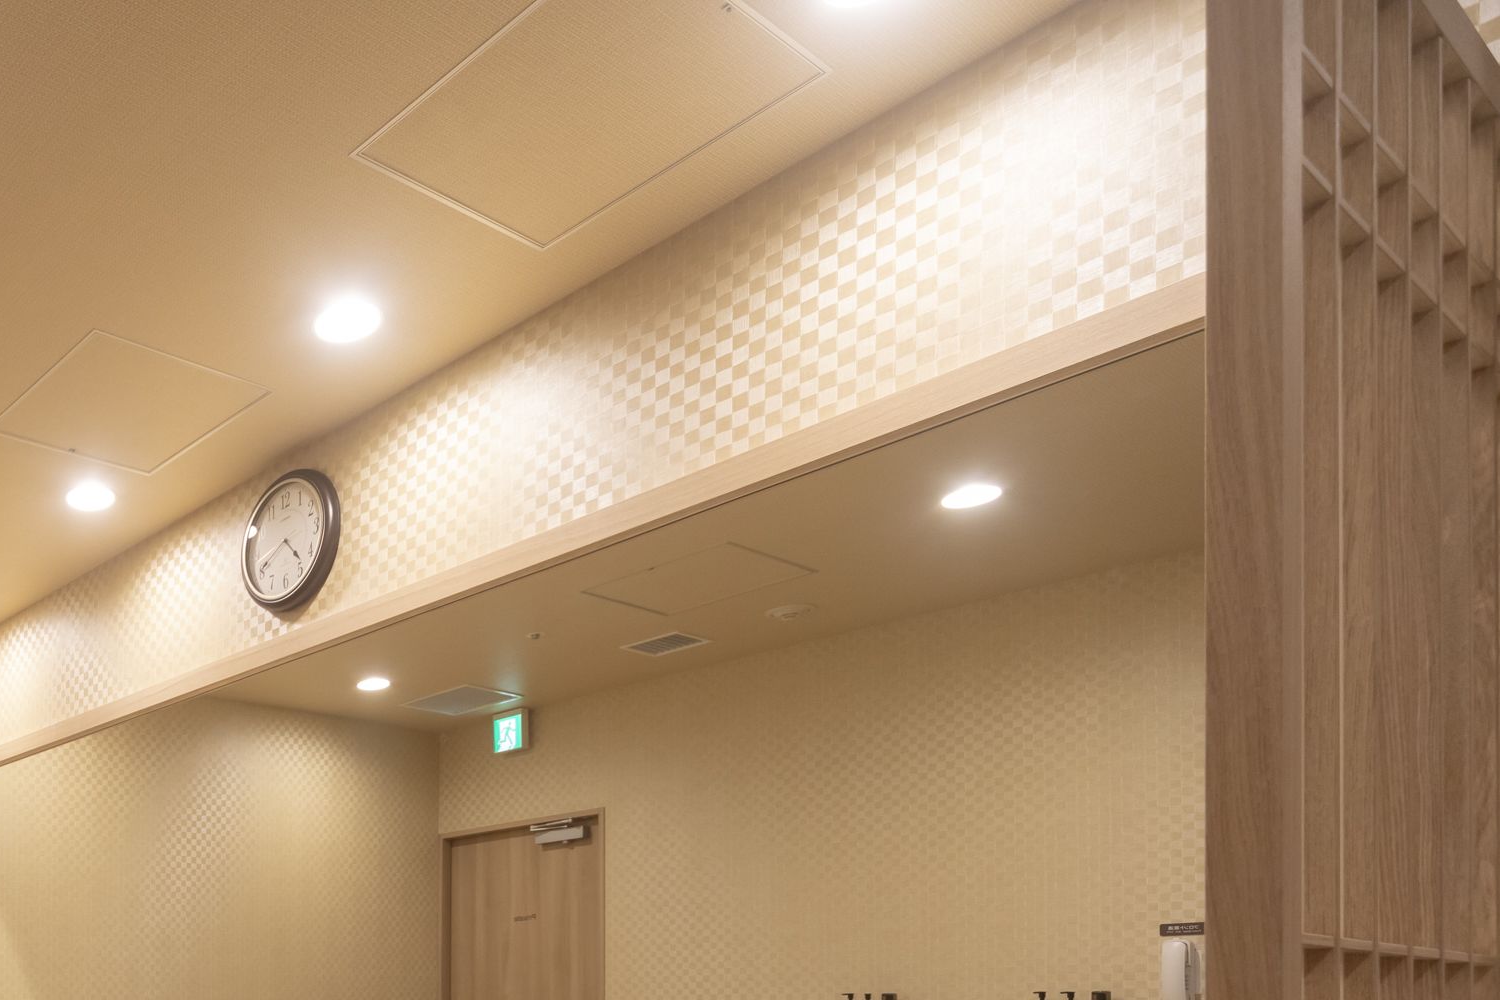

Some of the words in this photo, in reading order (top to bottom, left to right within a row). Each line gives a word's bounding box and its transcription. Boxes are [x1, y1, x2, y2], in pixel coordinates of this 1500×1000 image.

[281, 490, 291, 510] 12
[298, 490, 302, 507] 1
[268, 504, 275, 521] 11
[307, 499, 314, 518] 2
[313, 517, 320, 535] 3
[307, 541, 314, 558] 4
[297, 561, 304, 578] 5
[269, 573, 275, 591] 7
[283, 572, 289, 590] 6
